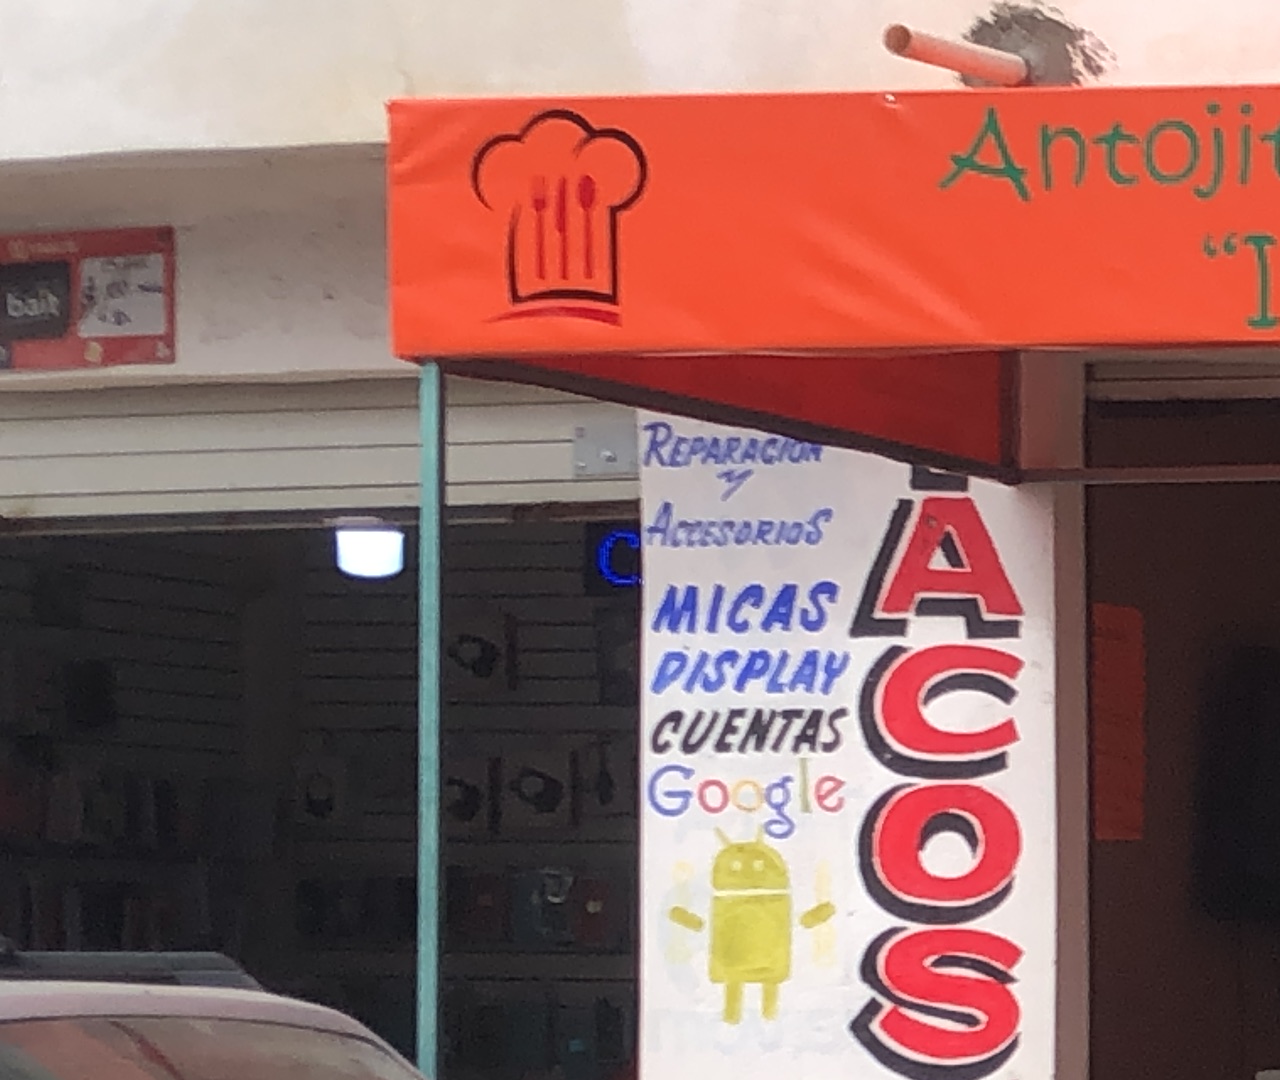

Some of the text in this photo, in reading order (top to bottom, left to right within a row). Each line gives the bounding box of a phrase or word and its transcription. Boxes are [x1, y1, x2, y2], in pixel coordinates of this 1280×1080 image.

[646, 501, 834, 548] ACCESORIOS
[651, 580, 840, 635] MICAS
[650, 648, 851, 695] DISPLAY
[649, 707, 852, 756] CUENTAS
[648, 757, 846, 839] Google
